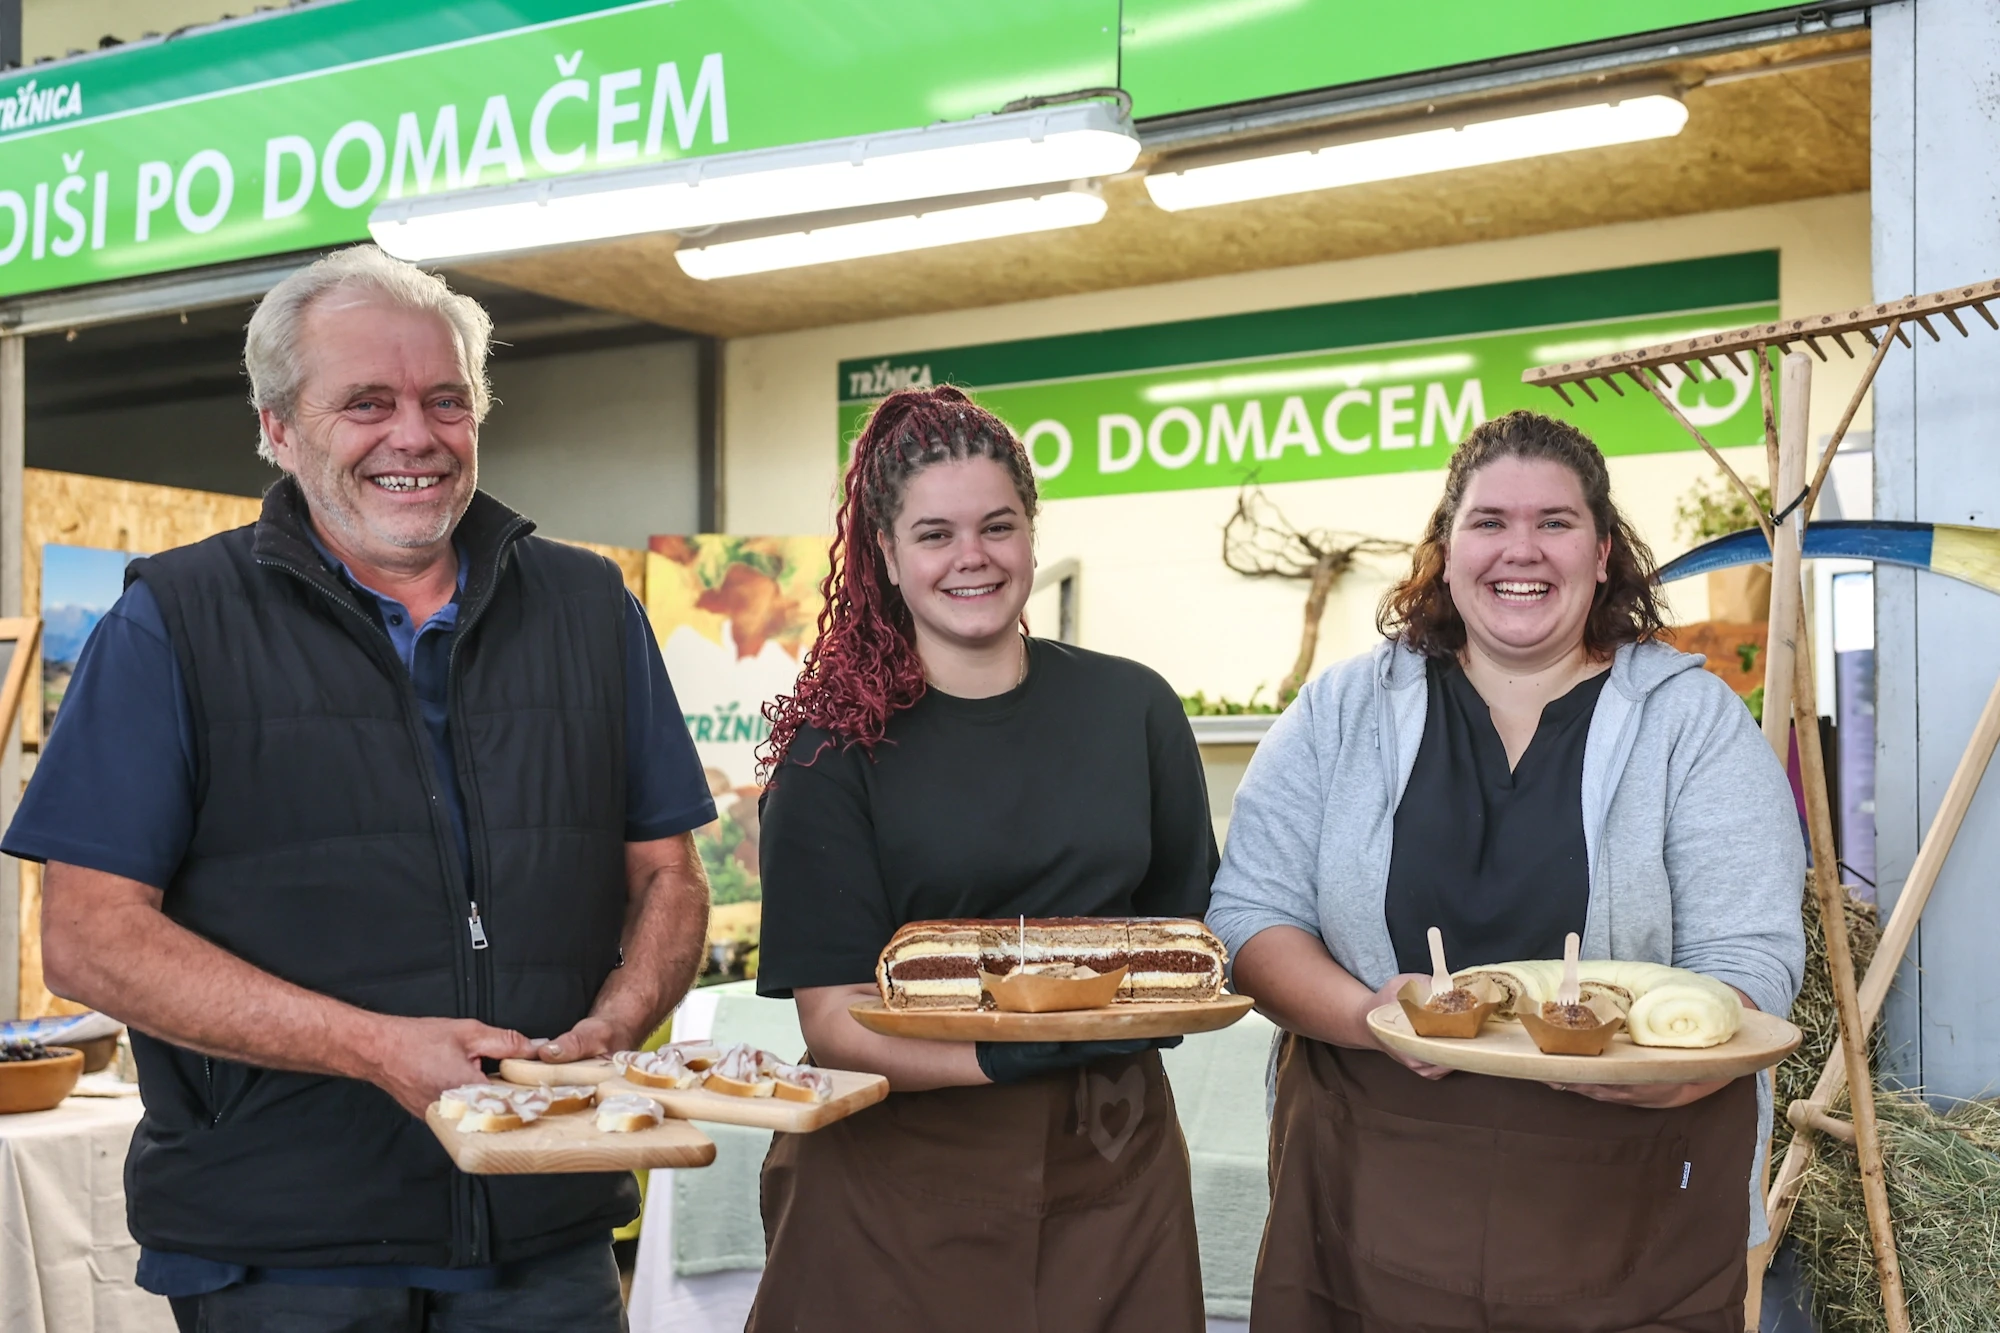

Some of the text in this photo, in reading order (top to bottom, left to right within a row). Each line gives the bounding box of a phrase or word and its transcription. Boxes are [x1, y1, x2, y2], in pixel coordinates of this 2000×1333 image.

[135, 149, 234, 242] PO
[263, 49, 729, 220] DOMAČEM
[848, 360, 933, 396] TRŽNICA
[1009, 370, 1487, 480] O DOMAČEM
